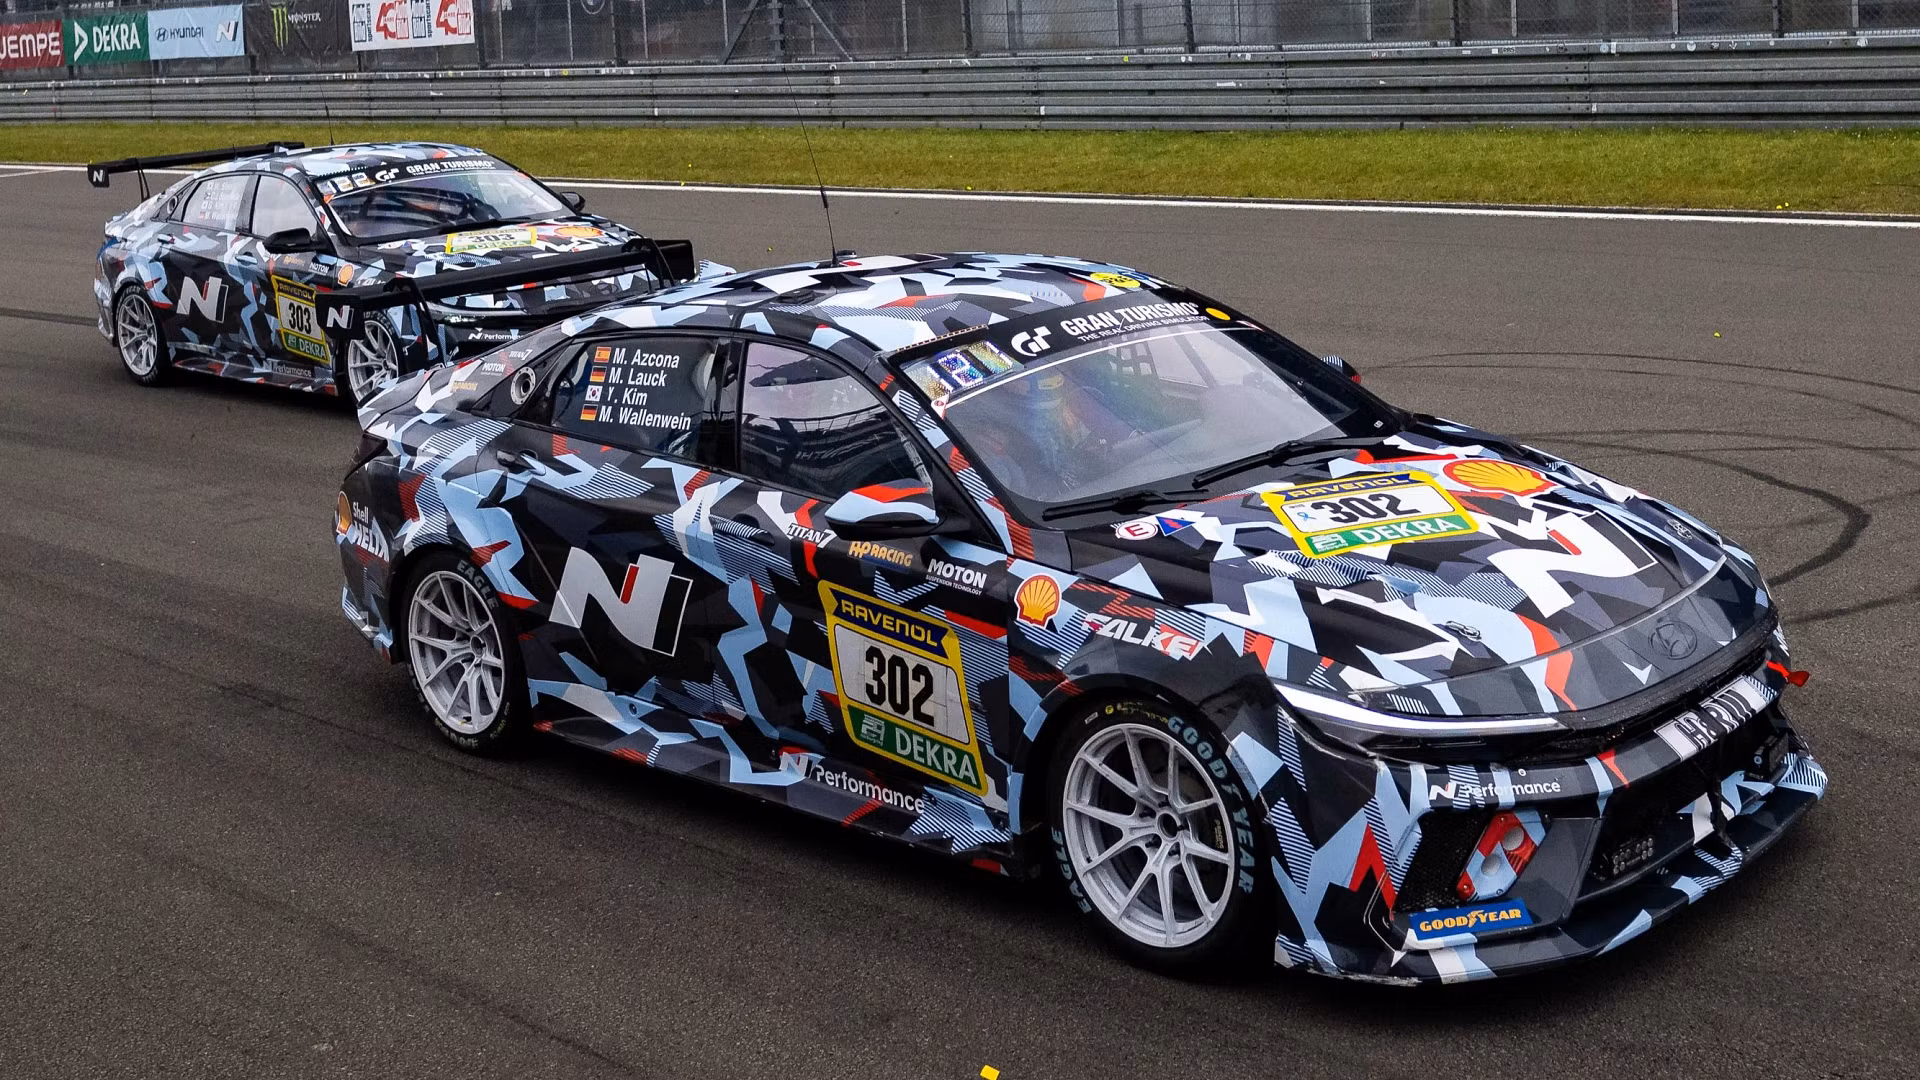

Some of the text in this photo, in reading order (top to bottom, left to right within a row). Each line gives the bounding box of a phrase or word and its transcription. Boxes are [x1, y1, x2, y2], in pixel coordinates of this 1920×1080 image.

[287, 11, 322, 24] MONSTER
[92, 22, 142, 53] DEKRA
[169, 27, 204, 39] HYUNDAI
[93, 170, 106, 183] N
[405, 162, 440, 175] GRAN
[176, 275, 229, 324] N
[287, 301, 312, 334] 303
[327, 305, 355, 330] N
[1060, 311, 1120, 337] GRAN
[1077, 315, 1211, 344] THE REAL DRIVING SIMULATOR
[298, 337, 327, 359] DEKRA
[612, 347, 680, 369] M. Azcona
[273, 363, 312, 378] Performance
[608, 366, 668, 387] M. Lauck
[622, 387, 648, 406] Kim
[598, 405, 692, 431] M. Wallenwein
[1286, 475, 1411, 499] RAVENOL
[352, 501, 369, 524] Shell
[1309, 493, 1421, 524] 302
[1352, 517, 1460, 545] DEKRA
[871, 545, 914, 569] RACING
[1487, 510, 1658, 619] N
[455, 558, 499, 609] EAGLE
[924, 575, 983, 598] SUSPENSION TECHNOLOGY
[927, 558, 988, 589] MOTON
[548, 547, 693, 657] N
[840, 599, 938, 648] RAVENOL
[865, 645, 935, 727] 302
[895, 727, 977, 785] DEKRA
[815, 764, 925, 814] Performance
[1429, 780, 1561, 801] N Performance
[1167, 715, 1255, 894] GOODYEAR
[1419, 908, 1522, 932] GOODYEAR
